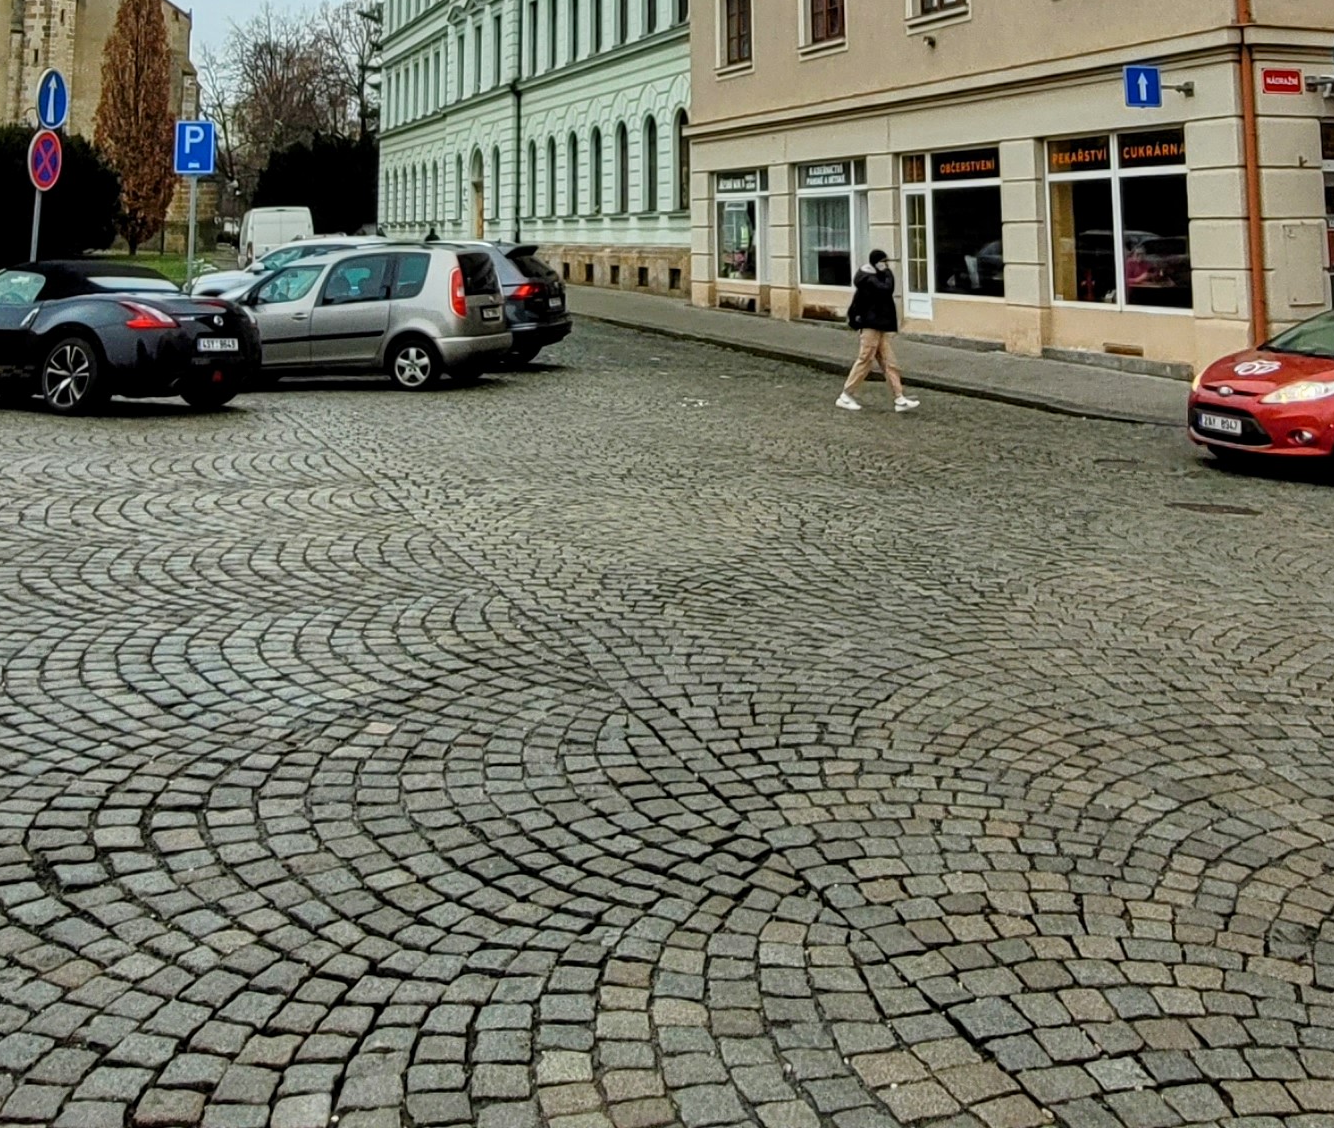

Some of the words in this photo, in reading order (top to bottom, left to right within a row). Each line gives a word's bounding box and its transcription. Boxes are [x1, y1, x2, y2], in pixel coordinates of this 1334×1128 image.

[185, 125, 204, 154] P
[1052, 147, 1107, 164] PEKAŘSTVÍ
[939, 157, 995, 174] OBČERSTVENÍ
